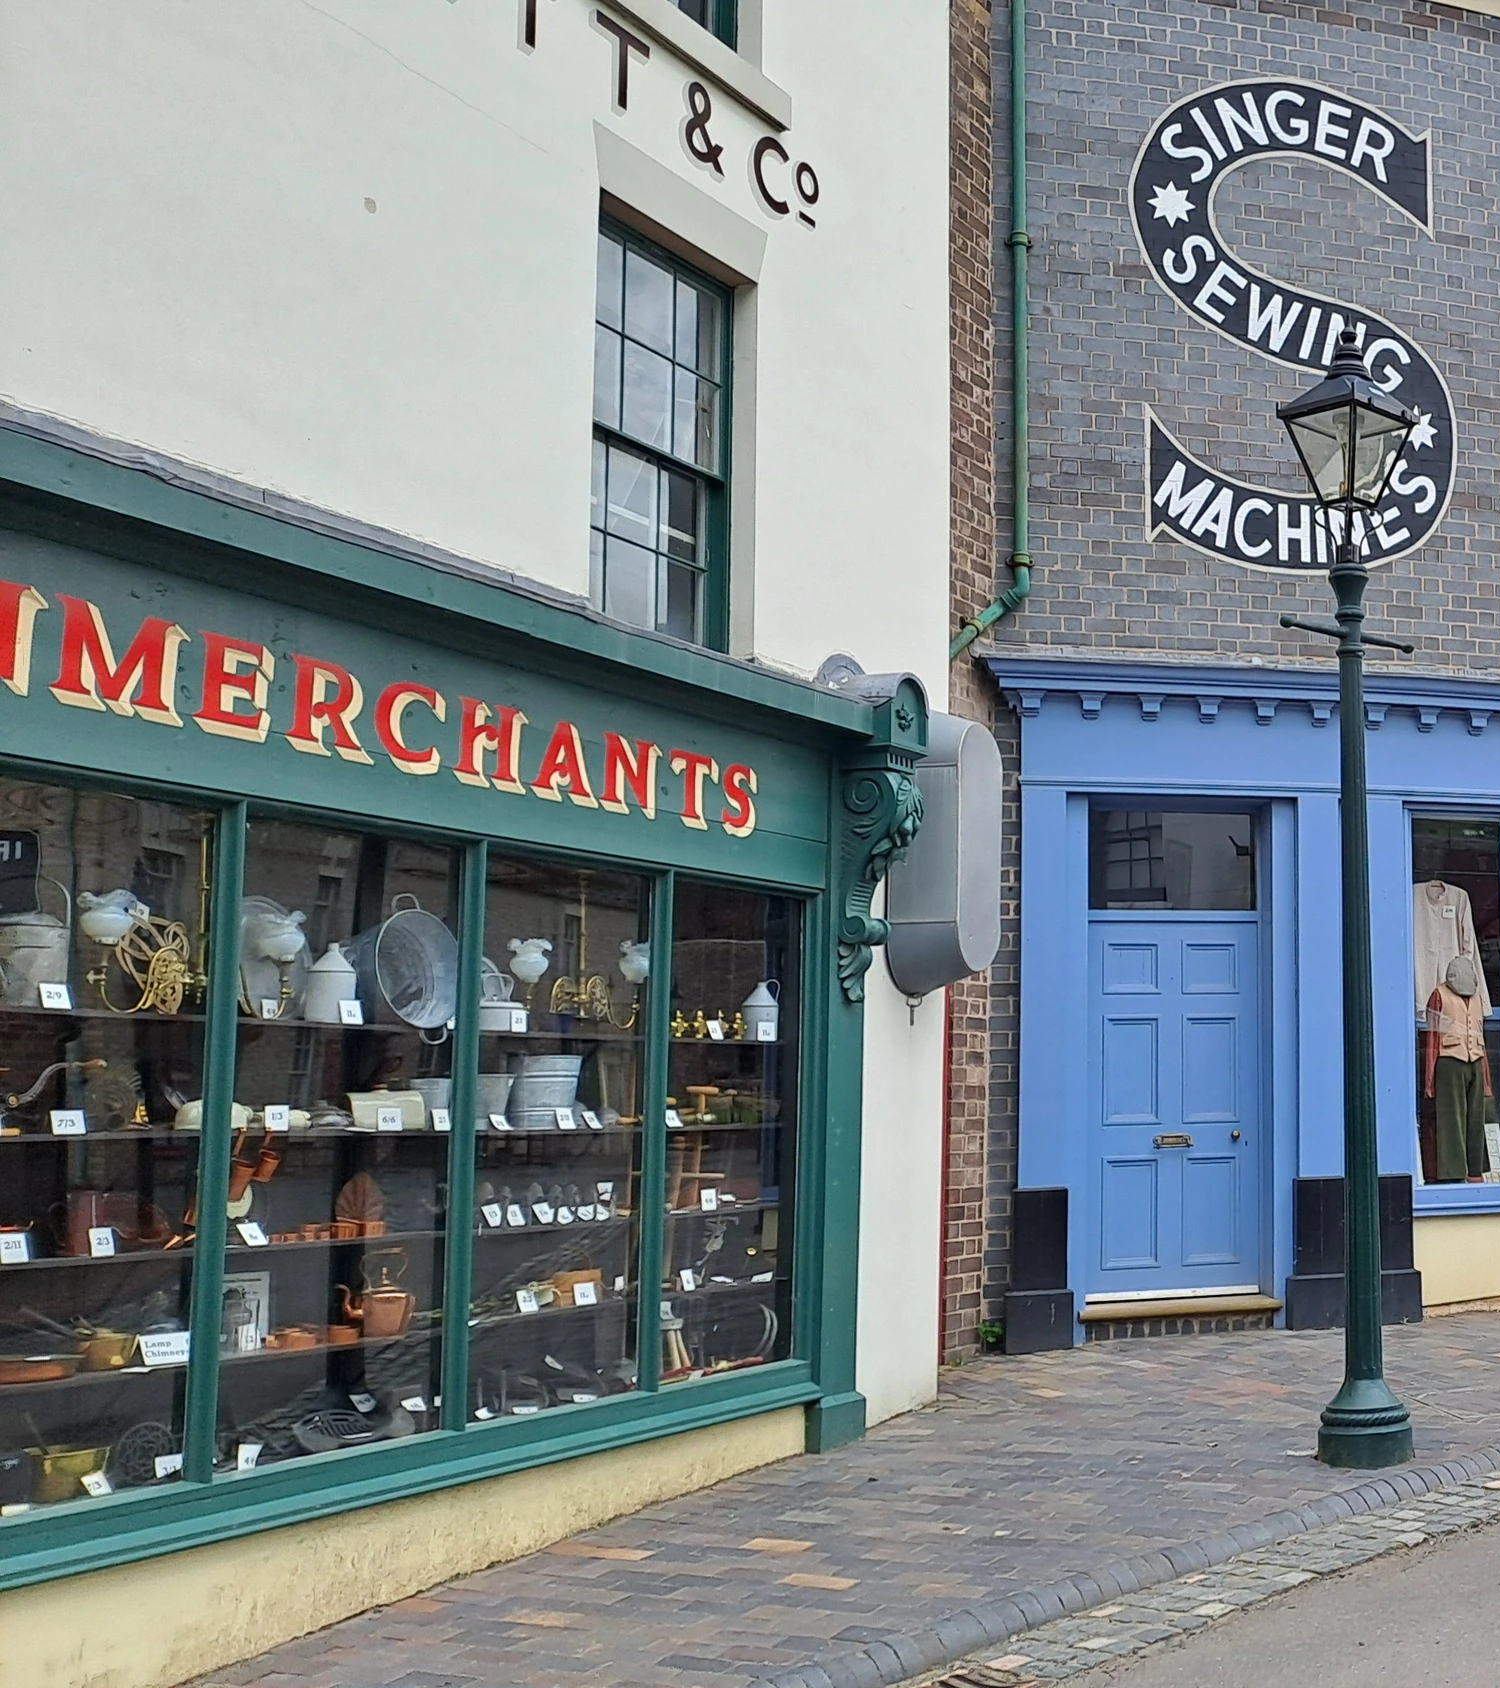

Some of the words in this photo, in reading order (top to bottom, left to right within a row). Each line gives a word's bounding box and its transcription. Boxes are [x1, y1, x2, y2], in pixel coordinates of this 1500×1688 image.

[681, 81, 726, 178] &
[1160, 89, 1396, 184] SINGER
[1162, 234, 1412, 392] SEWING
[46, 990, 62, 1000] 2/9
[144, 1339, 172, 1350] Lamp
